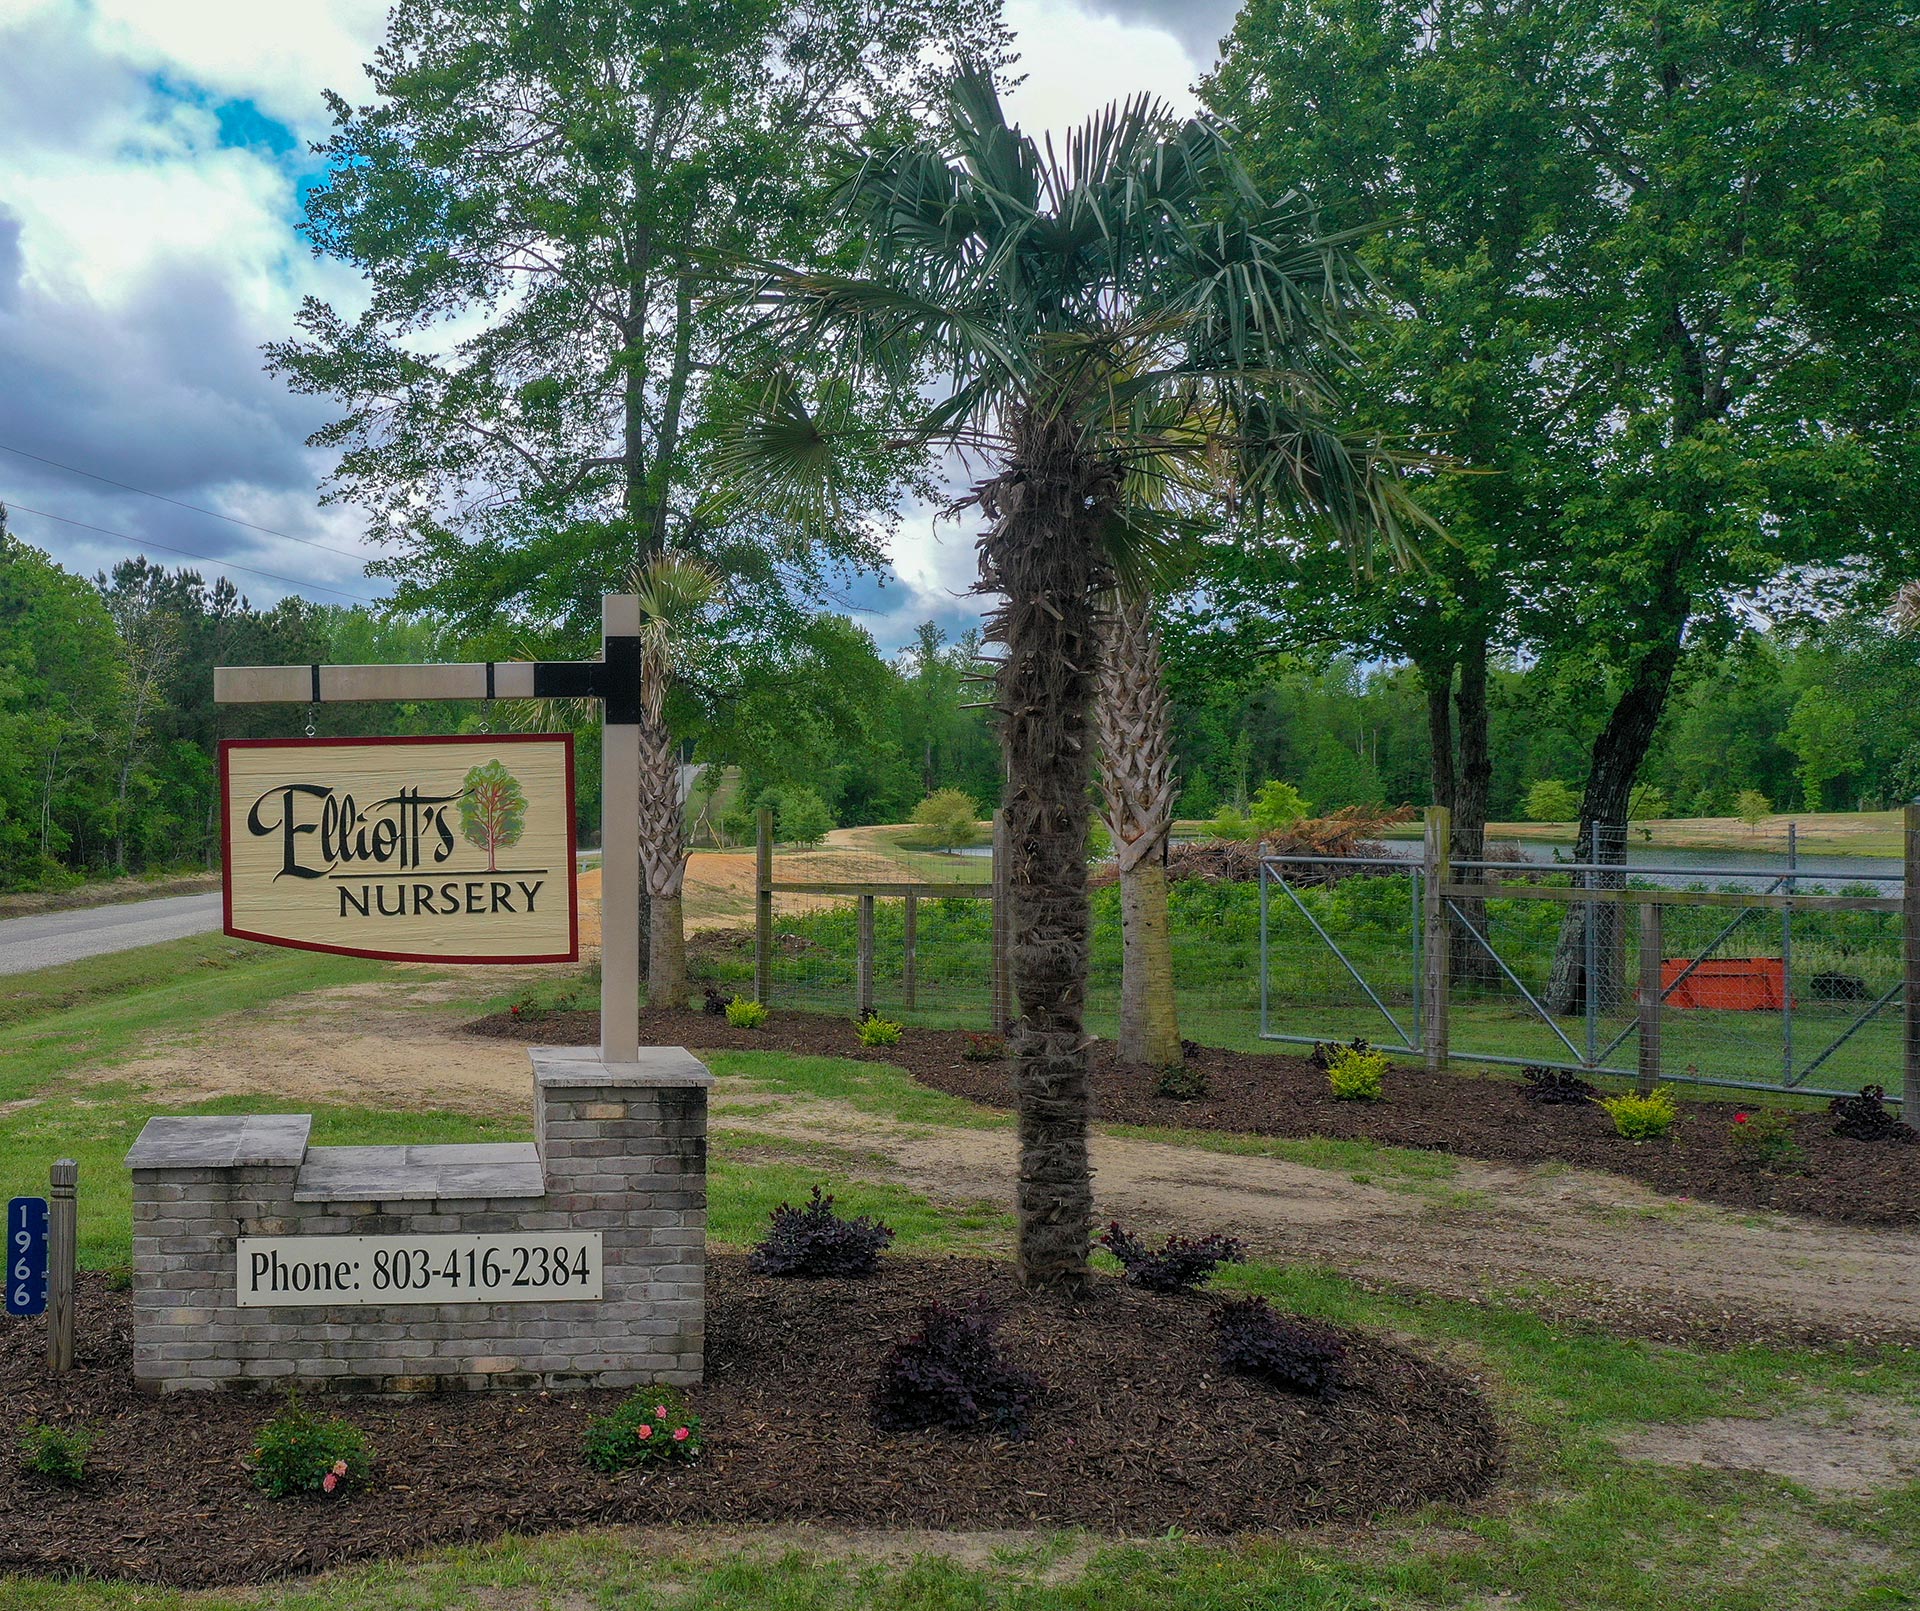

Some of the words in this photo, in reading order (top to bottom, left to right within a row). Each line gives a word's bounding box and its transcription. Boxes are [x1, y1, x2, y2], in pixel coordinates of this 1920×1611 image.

[247, 783, 475, 883] Elliott's
[336, 881, 545, 917] NURSERY
[13, 1204, 32, 1307] 1966
[250, 1249, 360, 1291] Phone:
[372, 1245, 591, 1290] 803-416-2384
